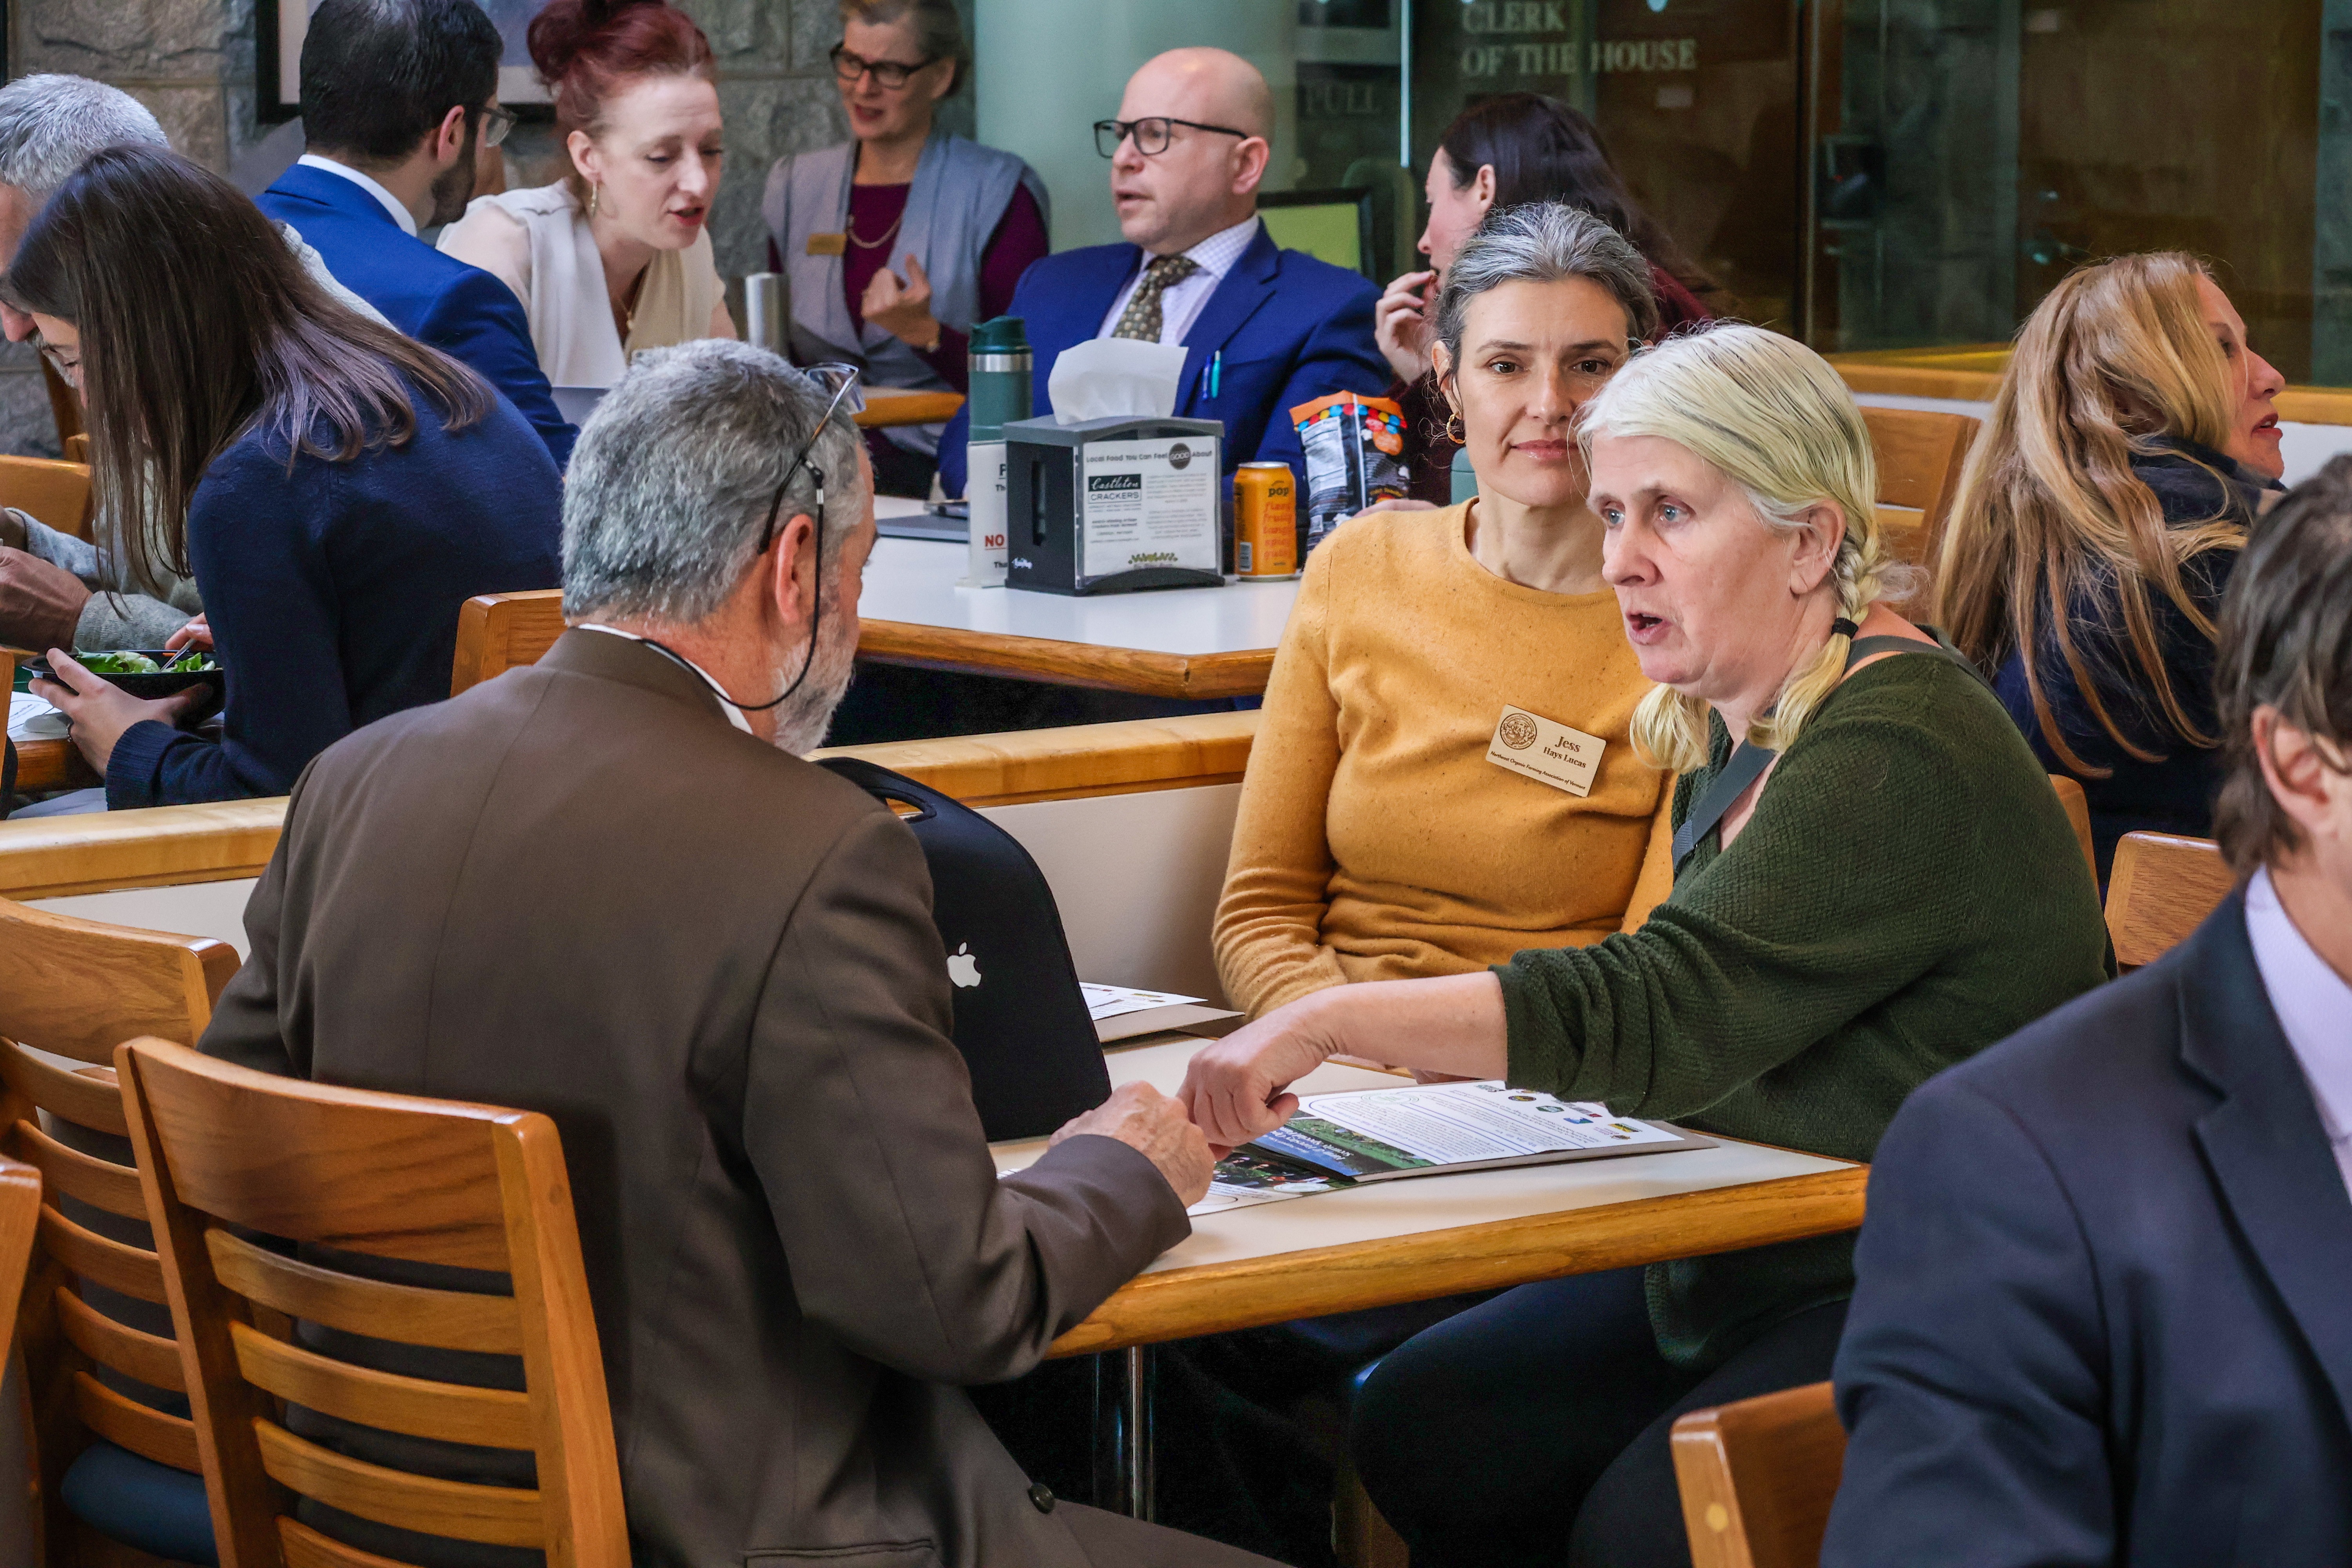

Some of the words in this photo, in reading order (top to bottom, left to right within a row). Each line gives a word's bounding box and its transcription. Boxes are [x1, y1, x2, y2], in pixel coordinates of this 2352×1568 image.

[1462, 0, 1566, 33] CLERK
[1462, 45, 1504, 76] OF
[1514, 42, 1577, 74] THE
[1590, 38, 1697, 71] HOUSE
[1268, 486, 1289, 497] pop
[985, 534, 1004, 546] NO
[1555, 736, 1581, 752] Jess
[1543, 747, 1563, 760] Hays
[1563, 754, 1586, 768] Lucas
[1490, 751, 1510, 762] Northeast
[1510, 758, 1526, 768] Organic
[1526, 764, 1542, 775] Farming
[1542, 771, 1564, 782] Association
[1570, 780, 1586, 789] Vermont
